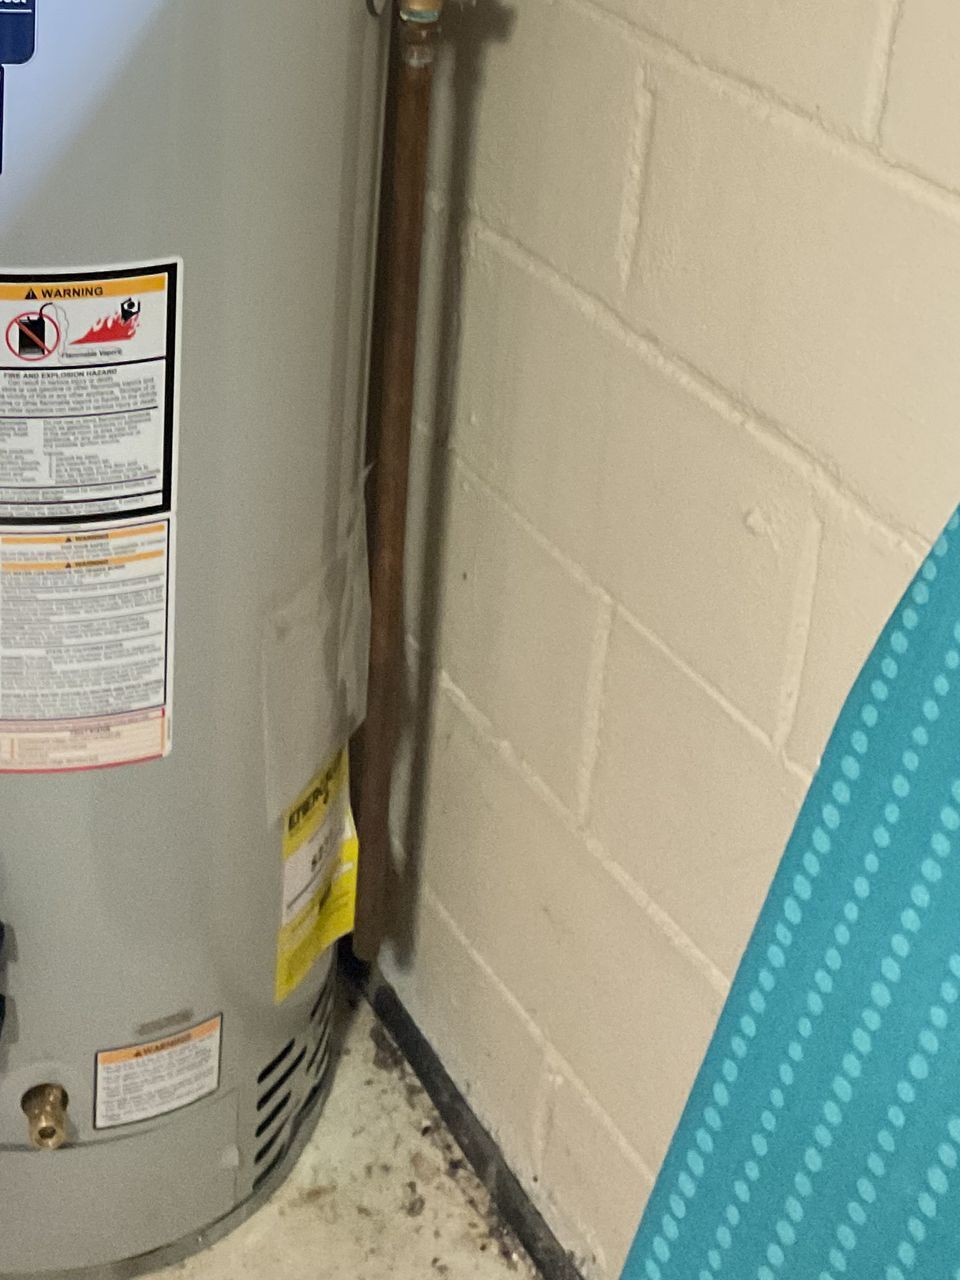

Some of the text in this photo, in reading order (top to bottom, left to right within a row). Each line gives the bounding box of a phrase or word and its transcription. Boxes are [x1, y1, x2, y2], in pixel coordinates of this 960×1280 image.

[41, 286, 104, 299] WARNING
[3, 369, 118, 380] FIRE AND EXPLOSION HAZARD
